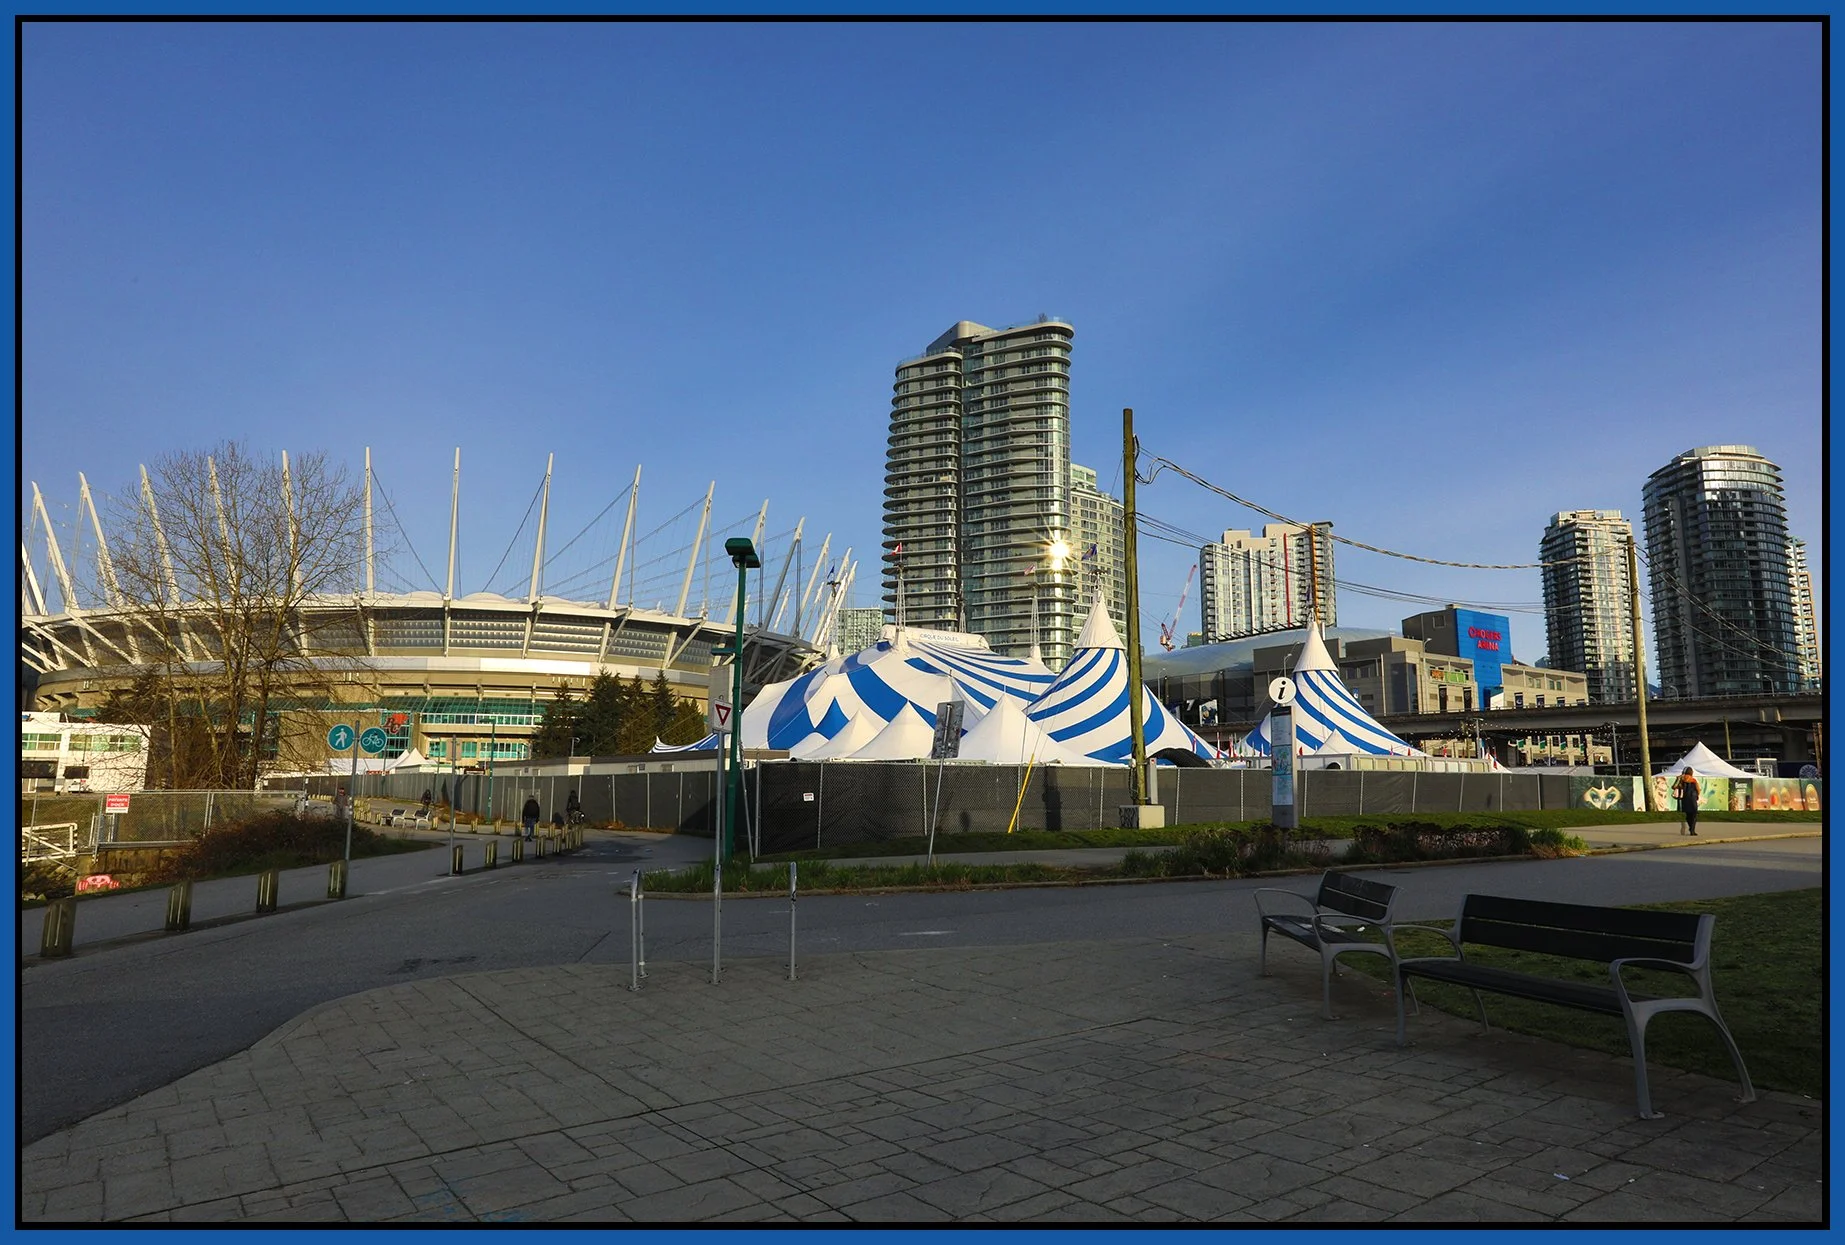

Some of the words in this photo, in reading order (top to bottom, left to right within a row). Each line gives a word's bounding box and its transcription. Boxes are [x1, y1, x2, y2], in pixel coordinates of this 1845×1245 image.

[1475, 628, 1502, 641] ROGERS
[1477, 640, 1498, 651] ARENA
[1186, 699, 1195, 711] 7
